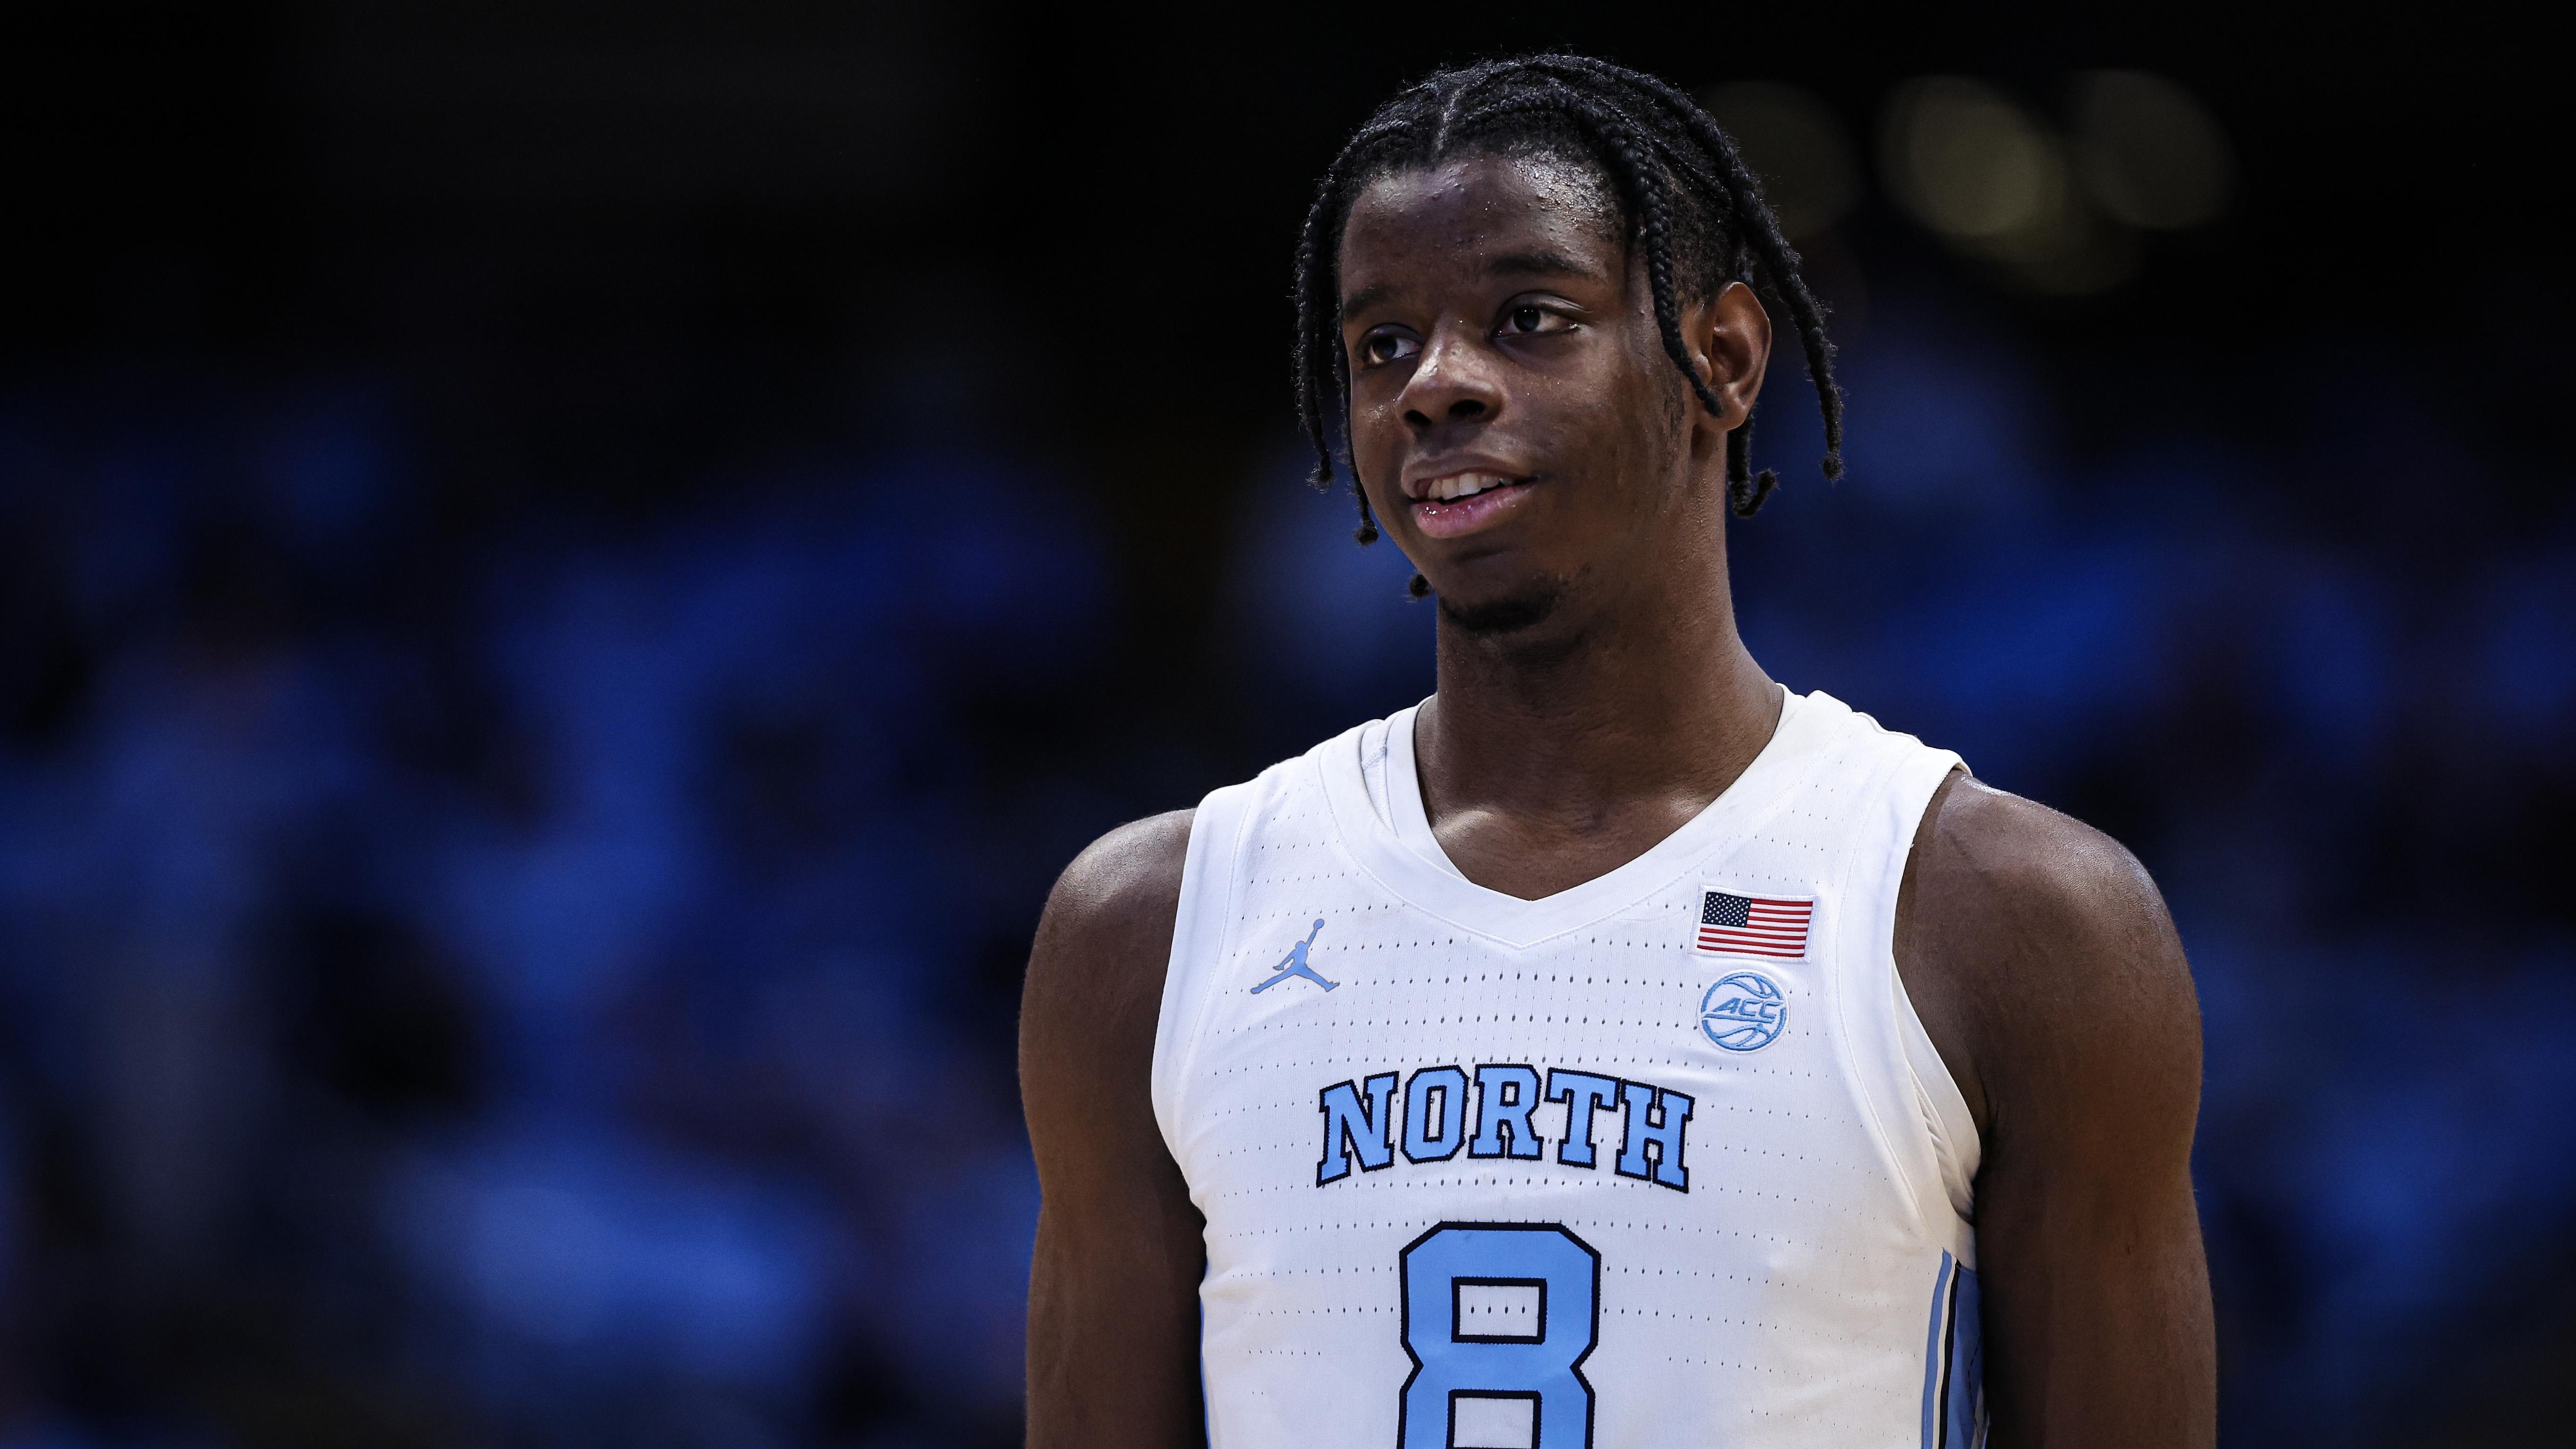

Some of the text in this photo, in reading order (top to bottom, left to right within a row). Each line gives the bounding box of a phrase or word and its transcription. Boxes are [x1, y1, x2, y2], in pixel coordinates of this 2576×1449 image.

[1713, 997, 1783, 1019] ACC
[1316, 1064, 1695, 1194] NORTH
[1396, 1221, 1601, 1449] 8
